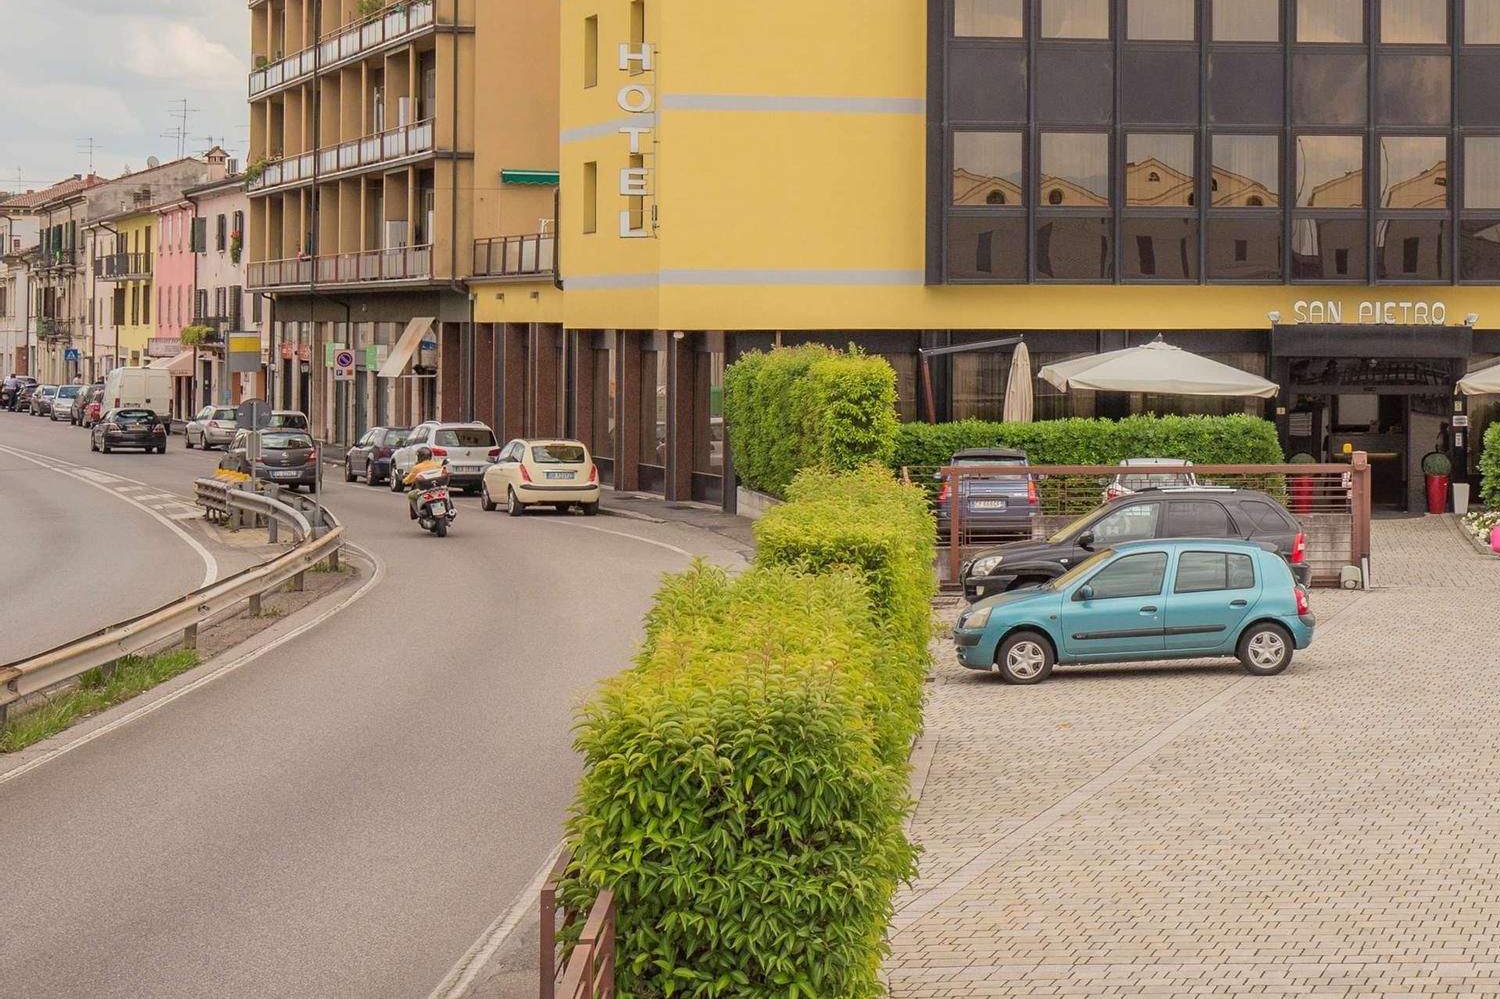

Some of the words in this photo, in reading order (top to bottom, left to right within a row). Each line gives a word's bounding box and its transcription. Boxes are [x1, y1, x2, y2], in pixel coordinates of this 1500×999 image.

[617, 43, 652, 239] HOTEL
[1294, 300, 1342, 324] SAN
[1359, 301, 1446, 325] PIETRO
